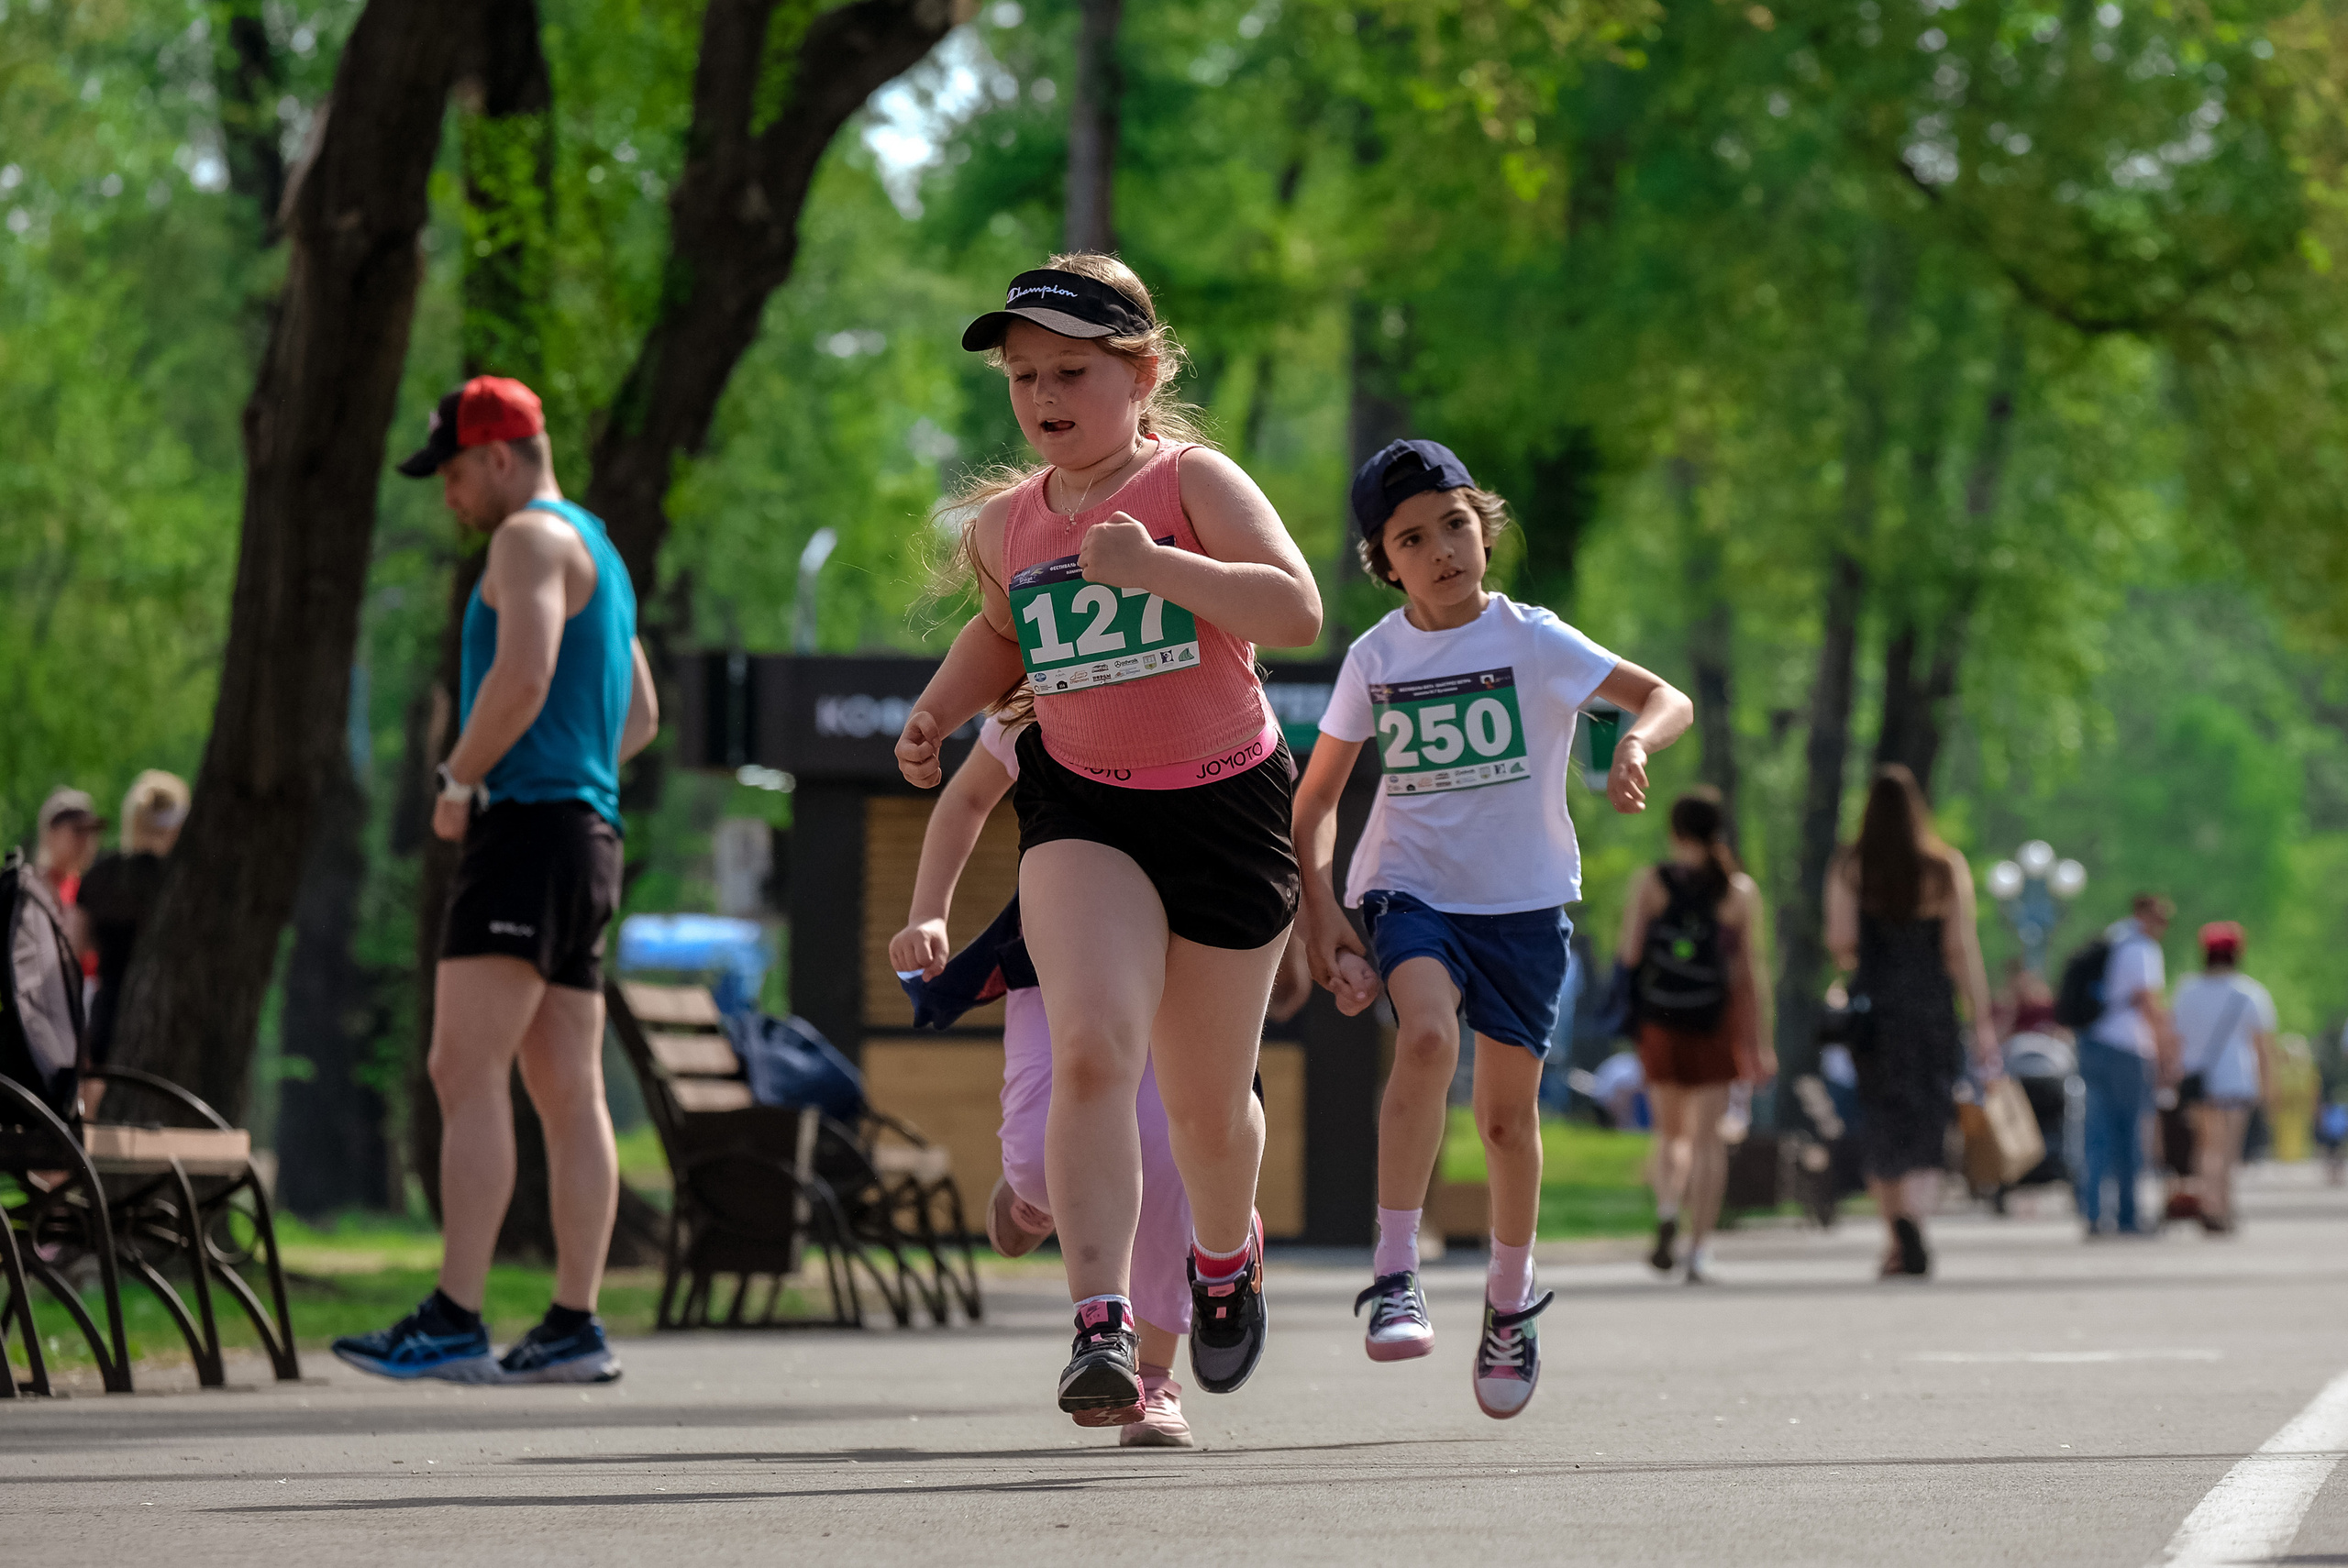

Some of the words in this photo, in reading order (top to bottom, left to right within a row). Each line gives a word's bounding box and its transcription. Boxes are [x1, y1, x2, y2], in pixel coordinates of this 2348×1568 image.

[1007, 284, 1078, 304] Champion
[1023, 584, 1165, 664] 127
[1379, 697, 1512, 768] 250
[1196, 741, 1263, 779] JOMOTO
